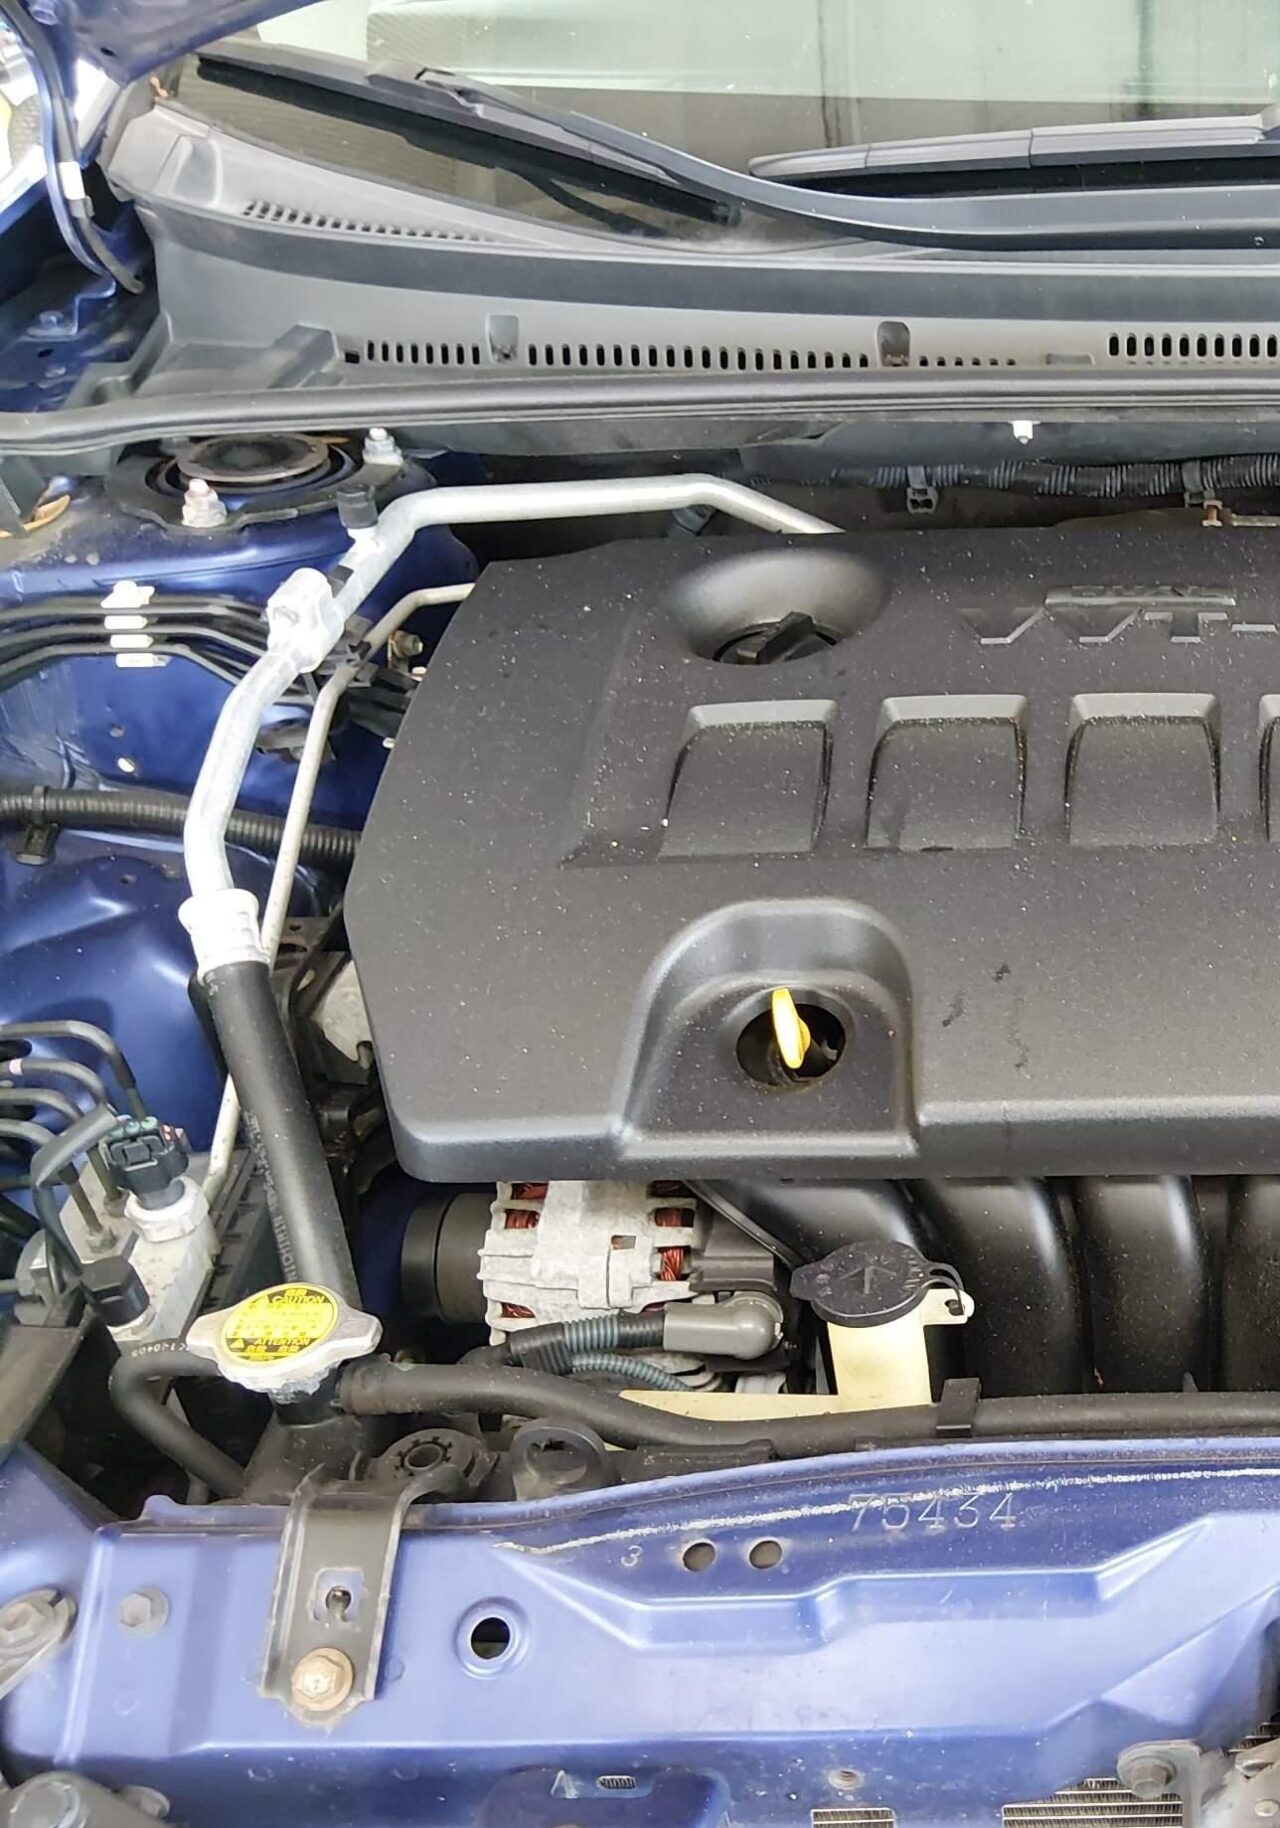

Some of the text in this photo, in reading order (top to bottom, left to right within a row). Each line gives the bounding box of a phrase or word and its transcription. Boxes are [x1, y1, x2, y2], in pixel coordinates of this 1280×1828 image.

[272, 1295, 325, 1304] CAUTION
[848, 1491, 1017, 1532] 75434
[621, 1545, 643, 1567] 3
